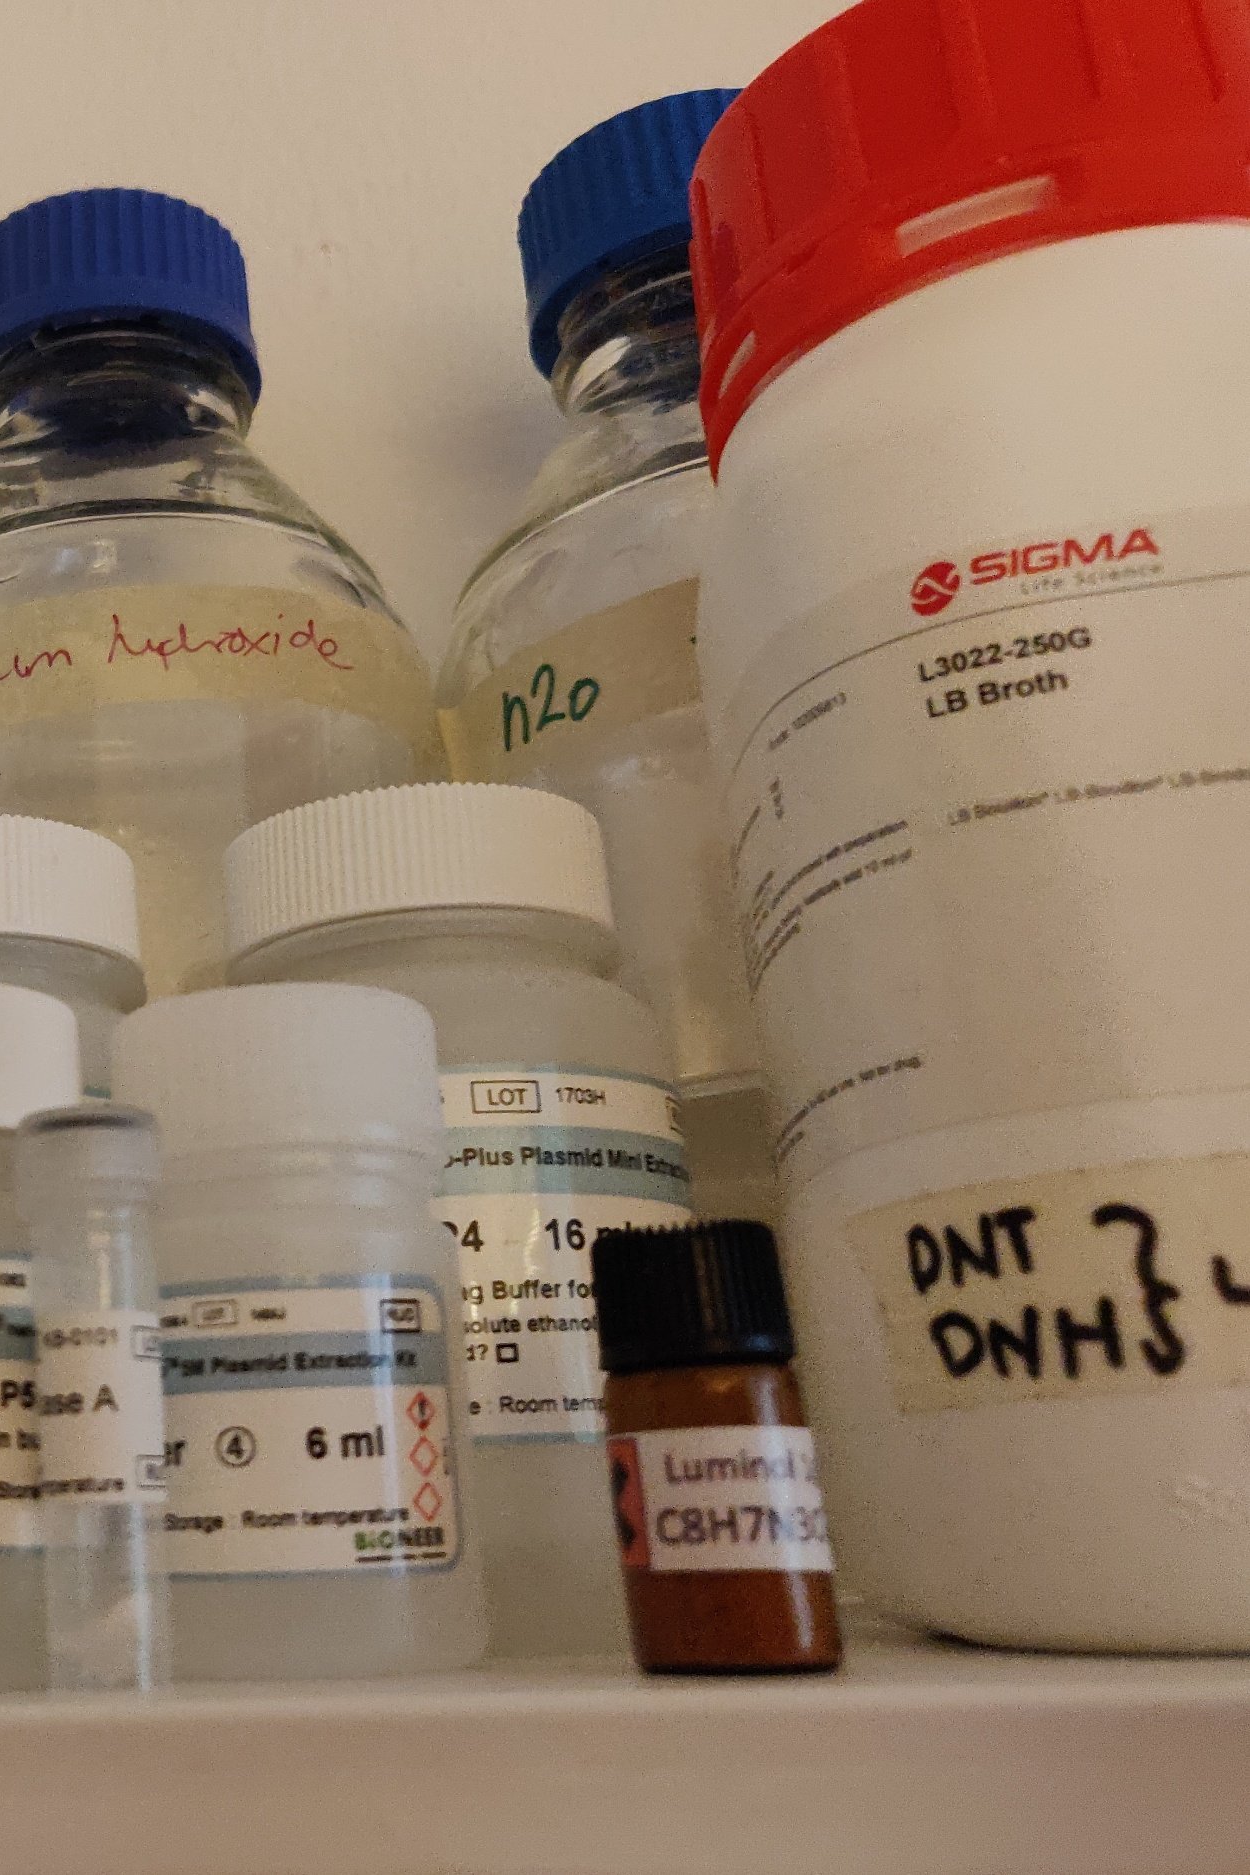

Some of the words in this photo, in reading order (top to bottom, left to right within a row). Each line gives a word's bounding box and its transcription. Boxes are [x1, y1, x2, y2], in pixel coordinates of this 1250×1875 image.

[970, 527, 1159, 585] SIGMA
[108, 614, 354, 671] hydroxide
[918, 626, 1092, 682] L3022-250G
[926, 688, 969, 719] LB
[978, 669, 1069, 706] Broth
[487, 1087, 528, 1106] LOT
[521, 1145, 601, 1168] Plasmid
[545, 1219, 586, 1252] 16
[906, 1206, 1037, 1296] DNT
[492, 1280, 561, 1299] Buffer
[1, 1380, 37, 1409] P5
[93, 1384, 119, 1412] A
[500, 1397, 557, 1414] Room
[306, 1427, 328, 1460] 6
[341, 1424, 385, 1460] ml
